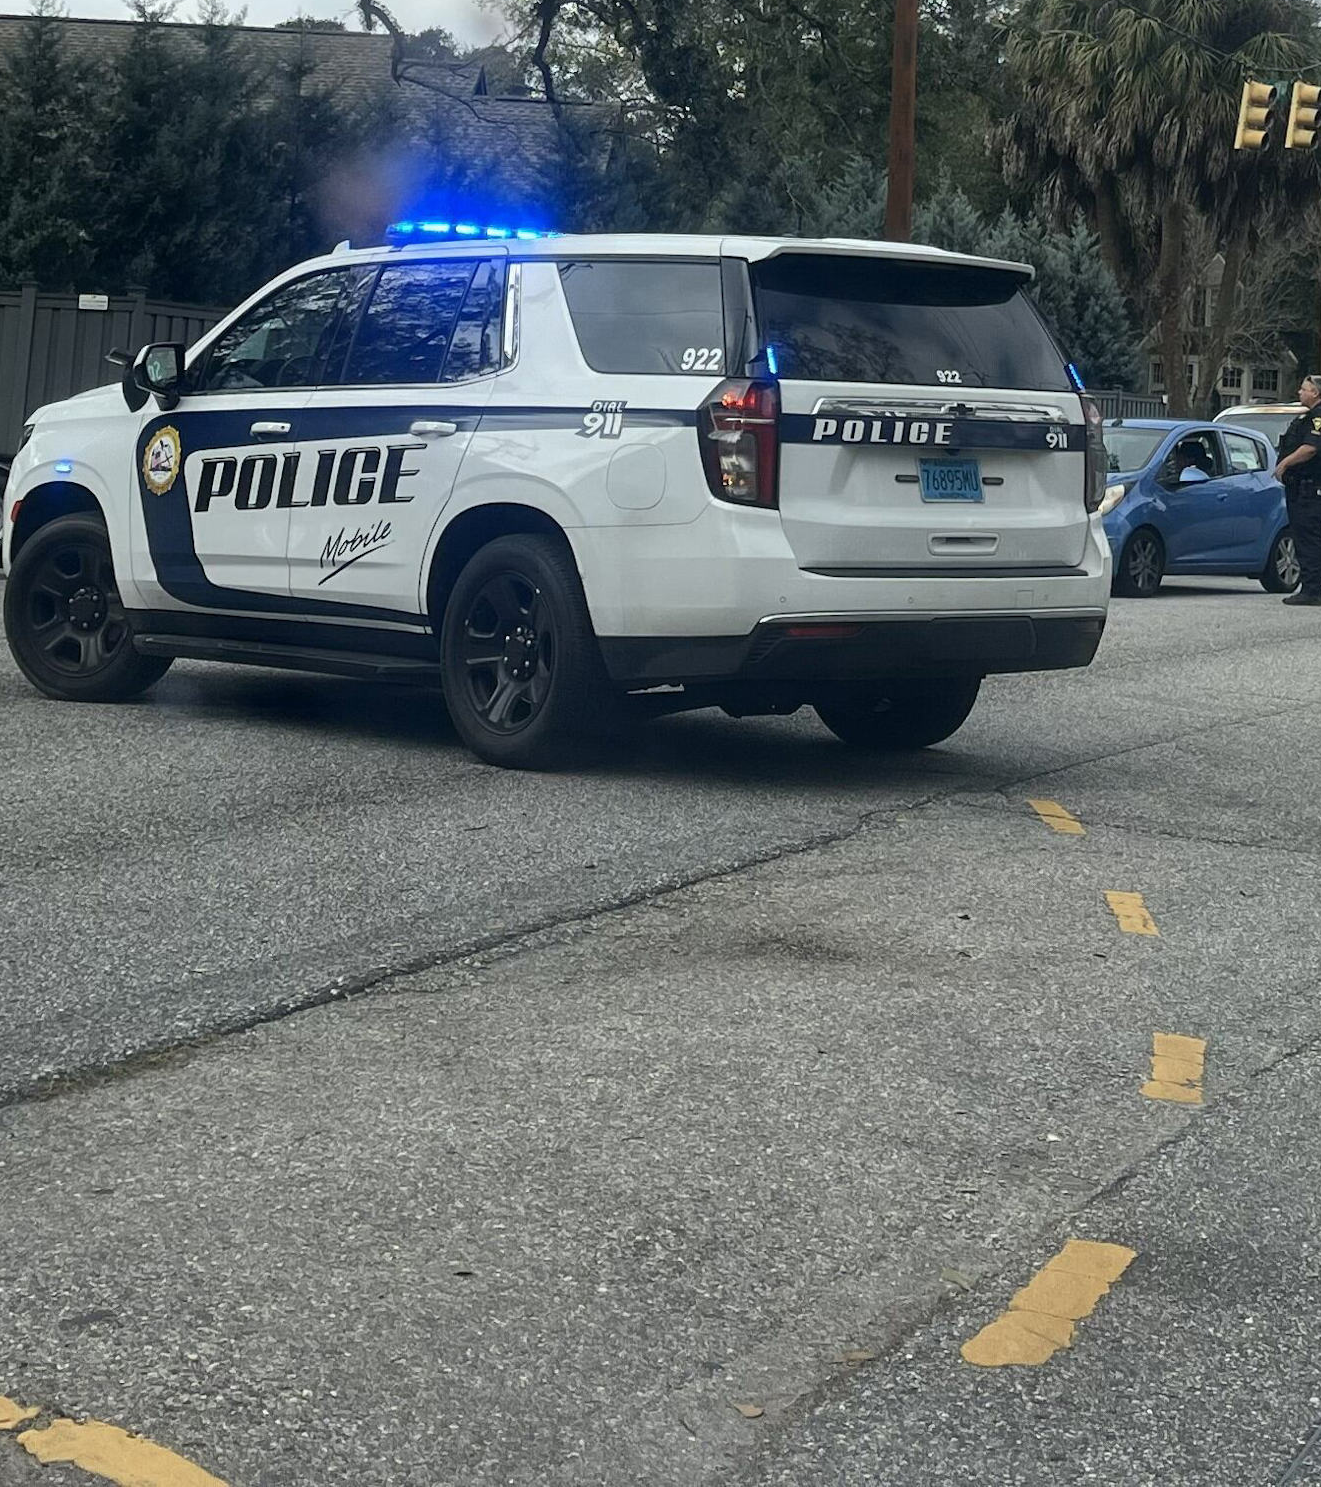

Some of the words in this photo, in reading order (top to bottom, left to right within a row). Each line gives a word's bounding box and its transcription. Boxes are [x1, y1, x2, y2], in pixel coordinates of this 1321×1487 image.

[680, 347, 723, 371] 922
[936, 370, 963, 383] 922
[591, 400, 625, 413] DIAL
[582, 412, 623, 436] 911
[812, 418, 954, 445] POLICE
[1045, 433, 1068, 449] 911
[194, 443, 427, 512] POLICE
[319, 519, 392, 568] Mobile
